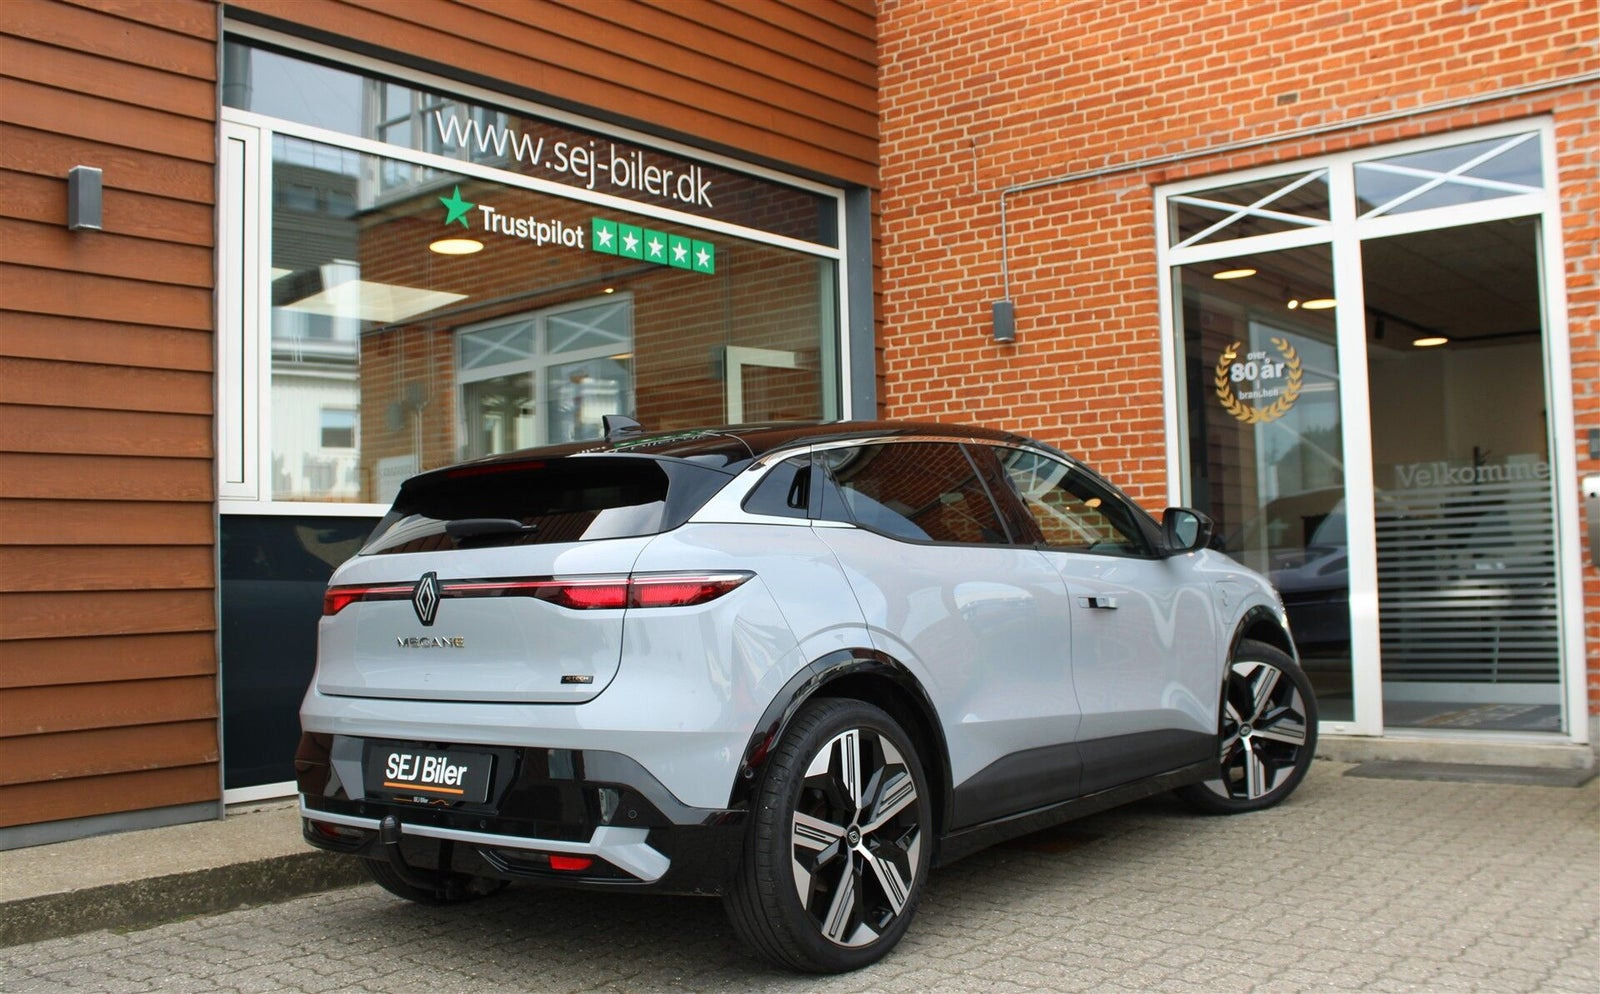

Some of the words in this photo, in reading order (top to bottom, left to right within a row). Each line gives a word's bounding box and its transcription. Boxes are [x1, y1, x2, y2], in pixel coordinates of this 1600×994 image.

[435, 110, 713, 207] www.sej-biler.dk
[478, 204, 584, 249] Trustpilot
[1230, 362, 1258, 382] 80
[1261, 357, 1285, 379] år
[385, 753, 421, 781] SEJ
[421, 756, 468, 786] Biler
